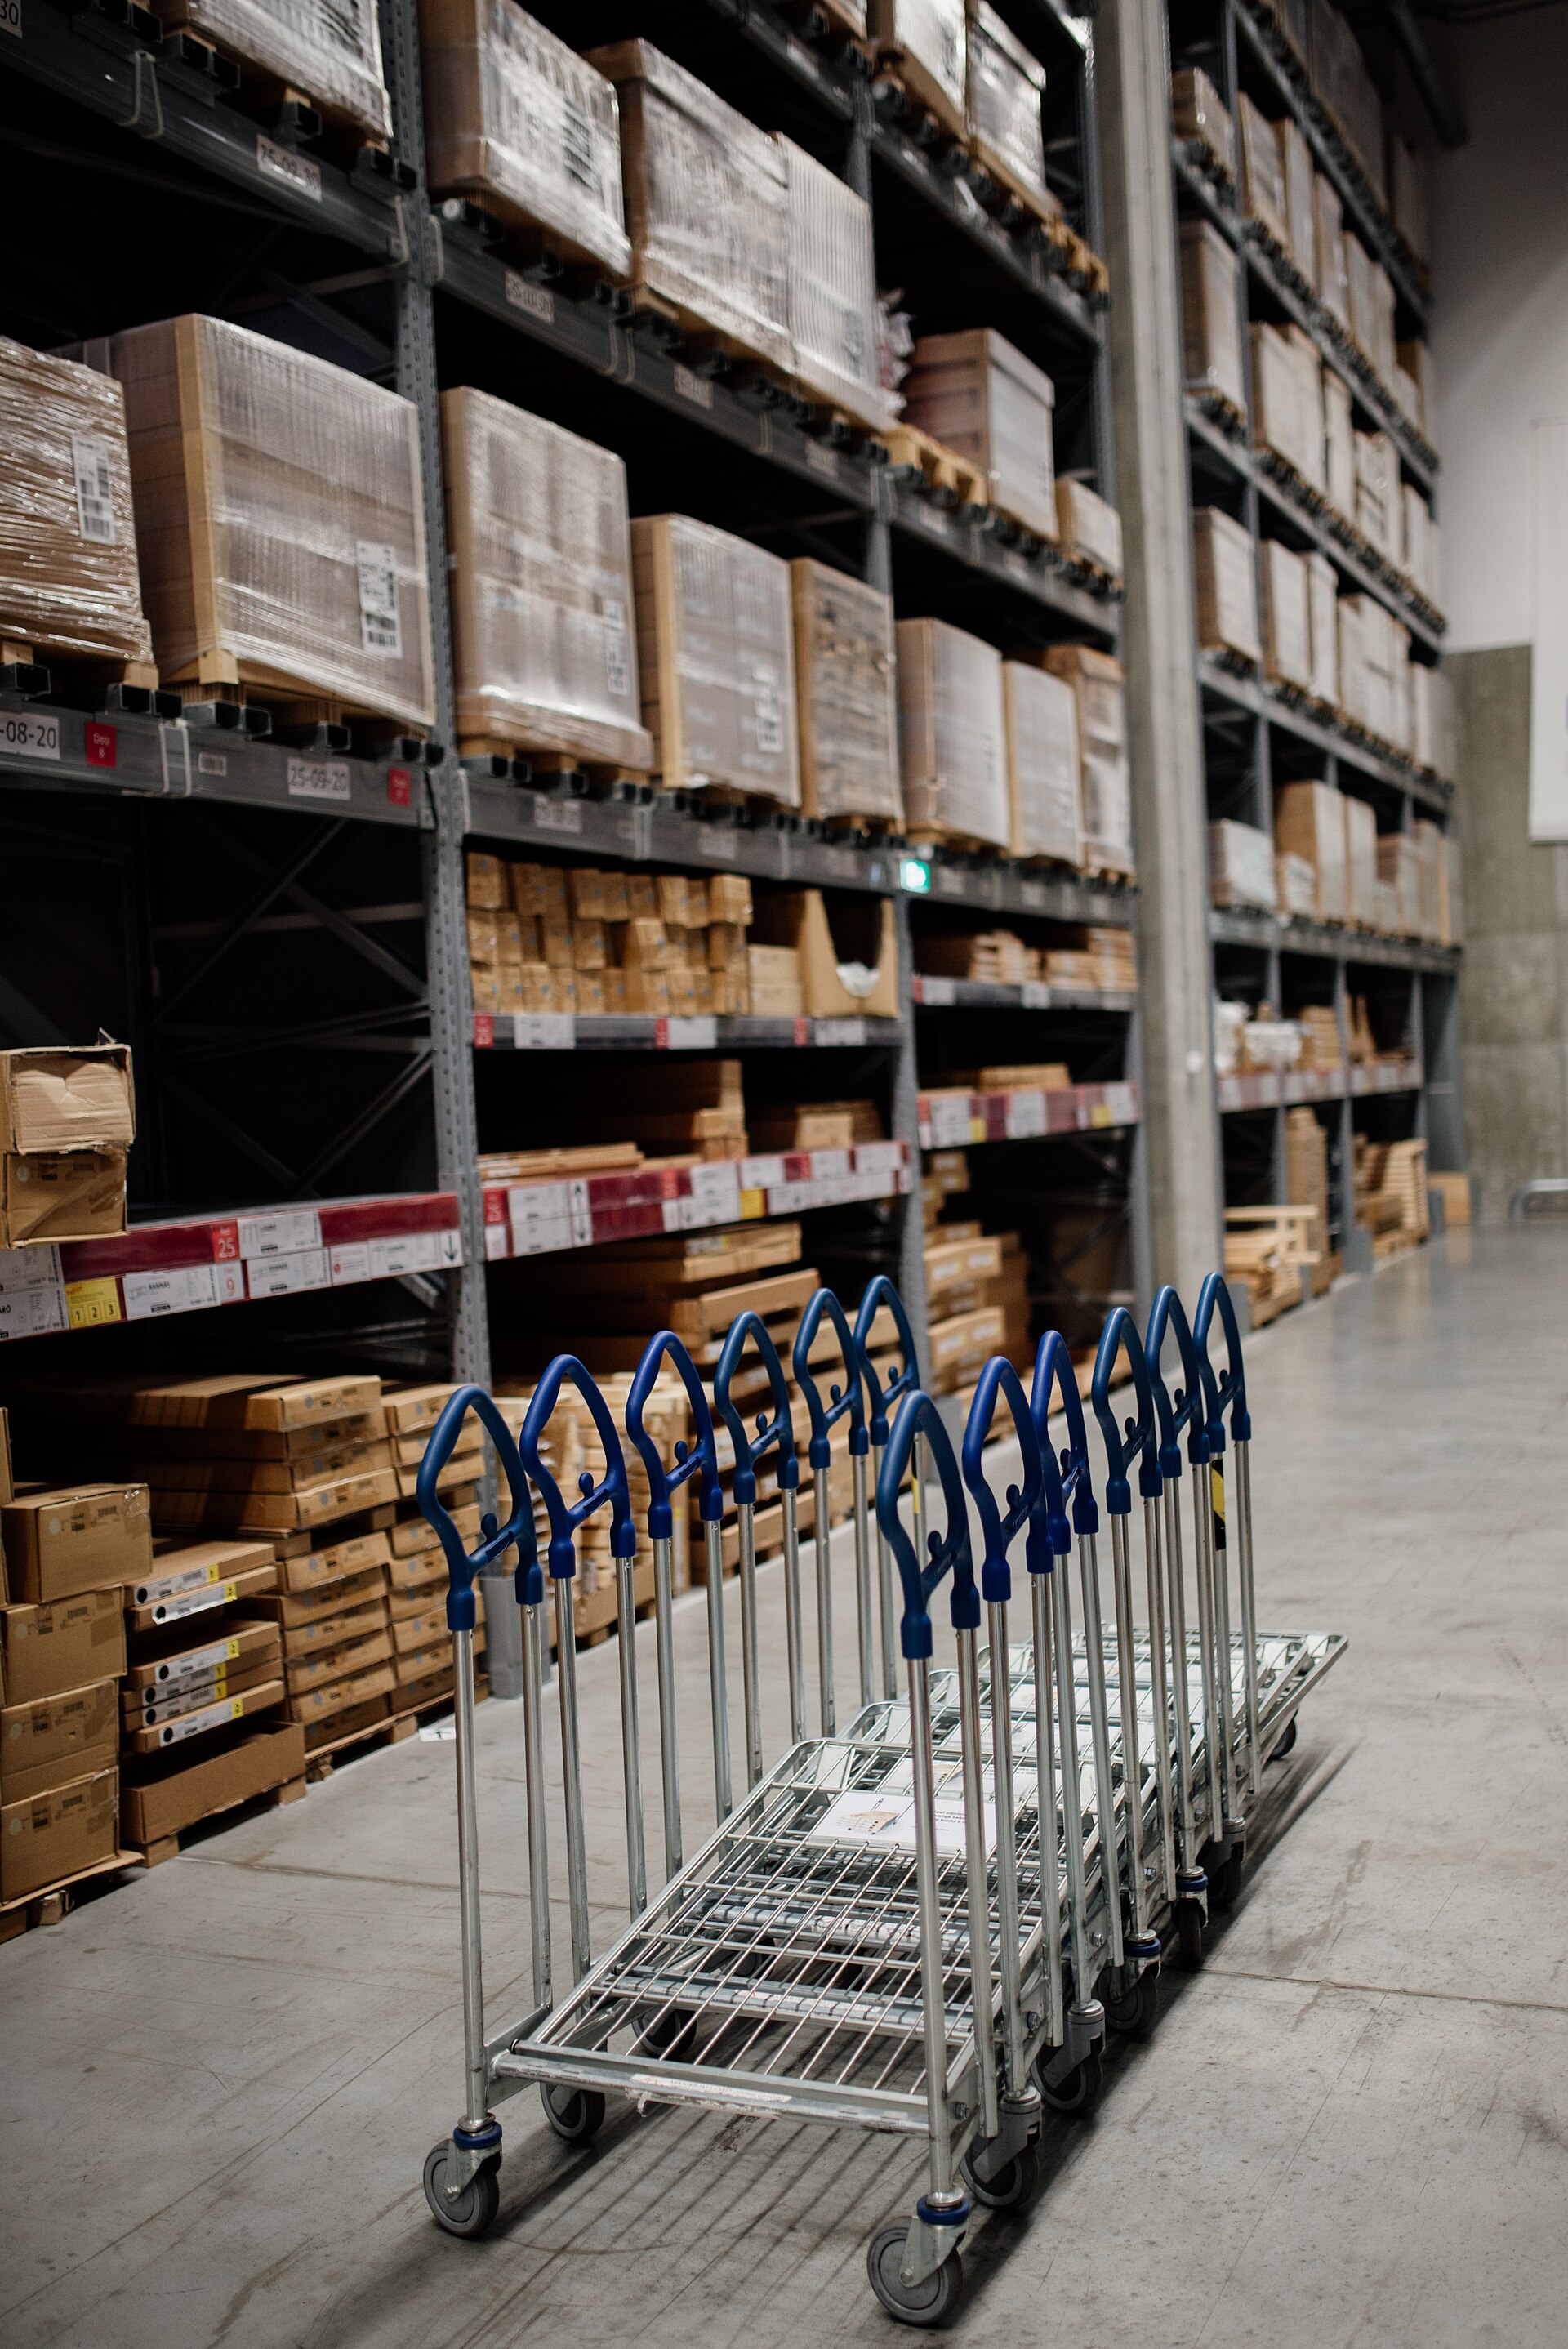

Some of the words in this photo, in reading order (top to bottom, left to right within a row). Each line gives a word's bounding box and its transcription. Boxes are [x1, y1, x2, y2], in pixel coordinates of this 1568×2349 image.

[218, 1237, 236, 1259] 25
[226, 1277, 235, 1297] 9
[75, 1310, 81, 1321] 1
[91, 1306, 97, 1318] 2
[109, 1304, 114, 1316] 3
